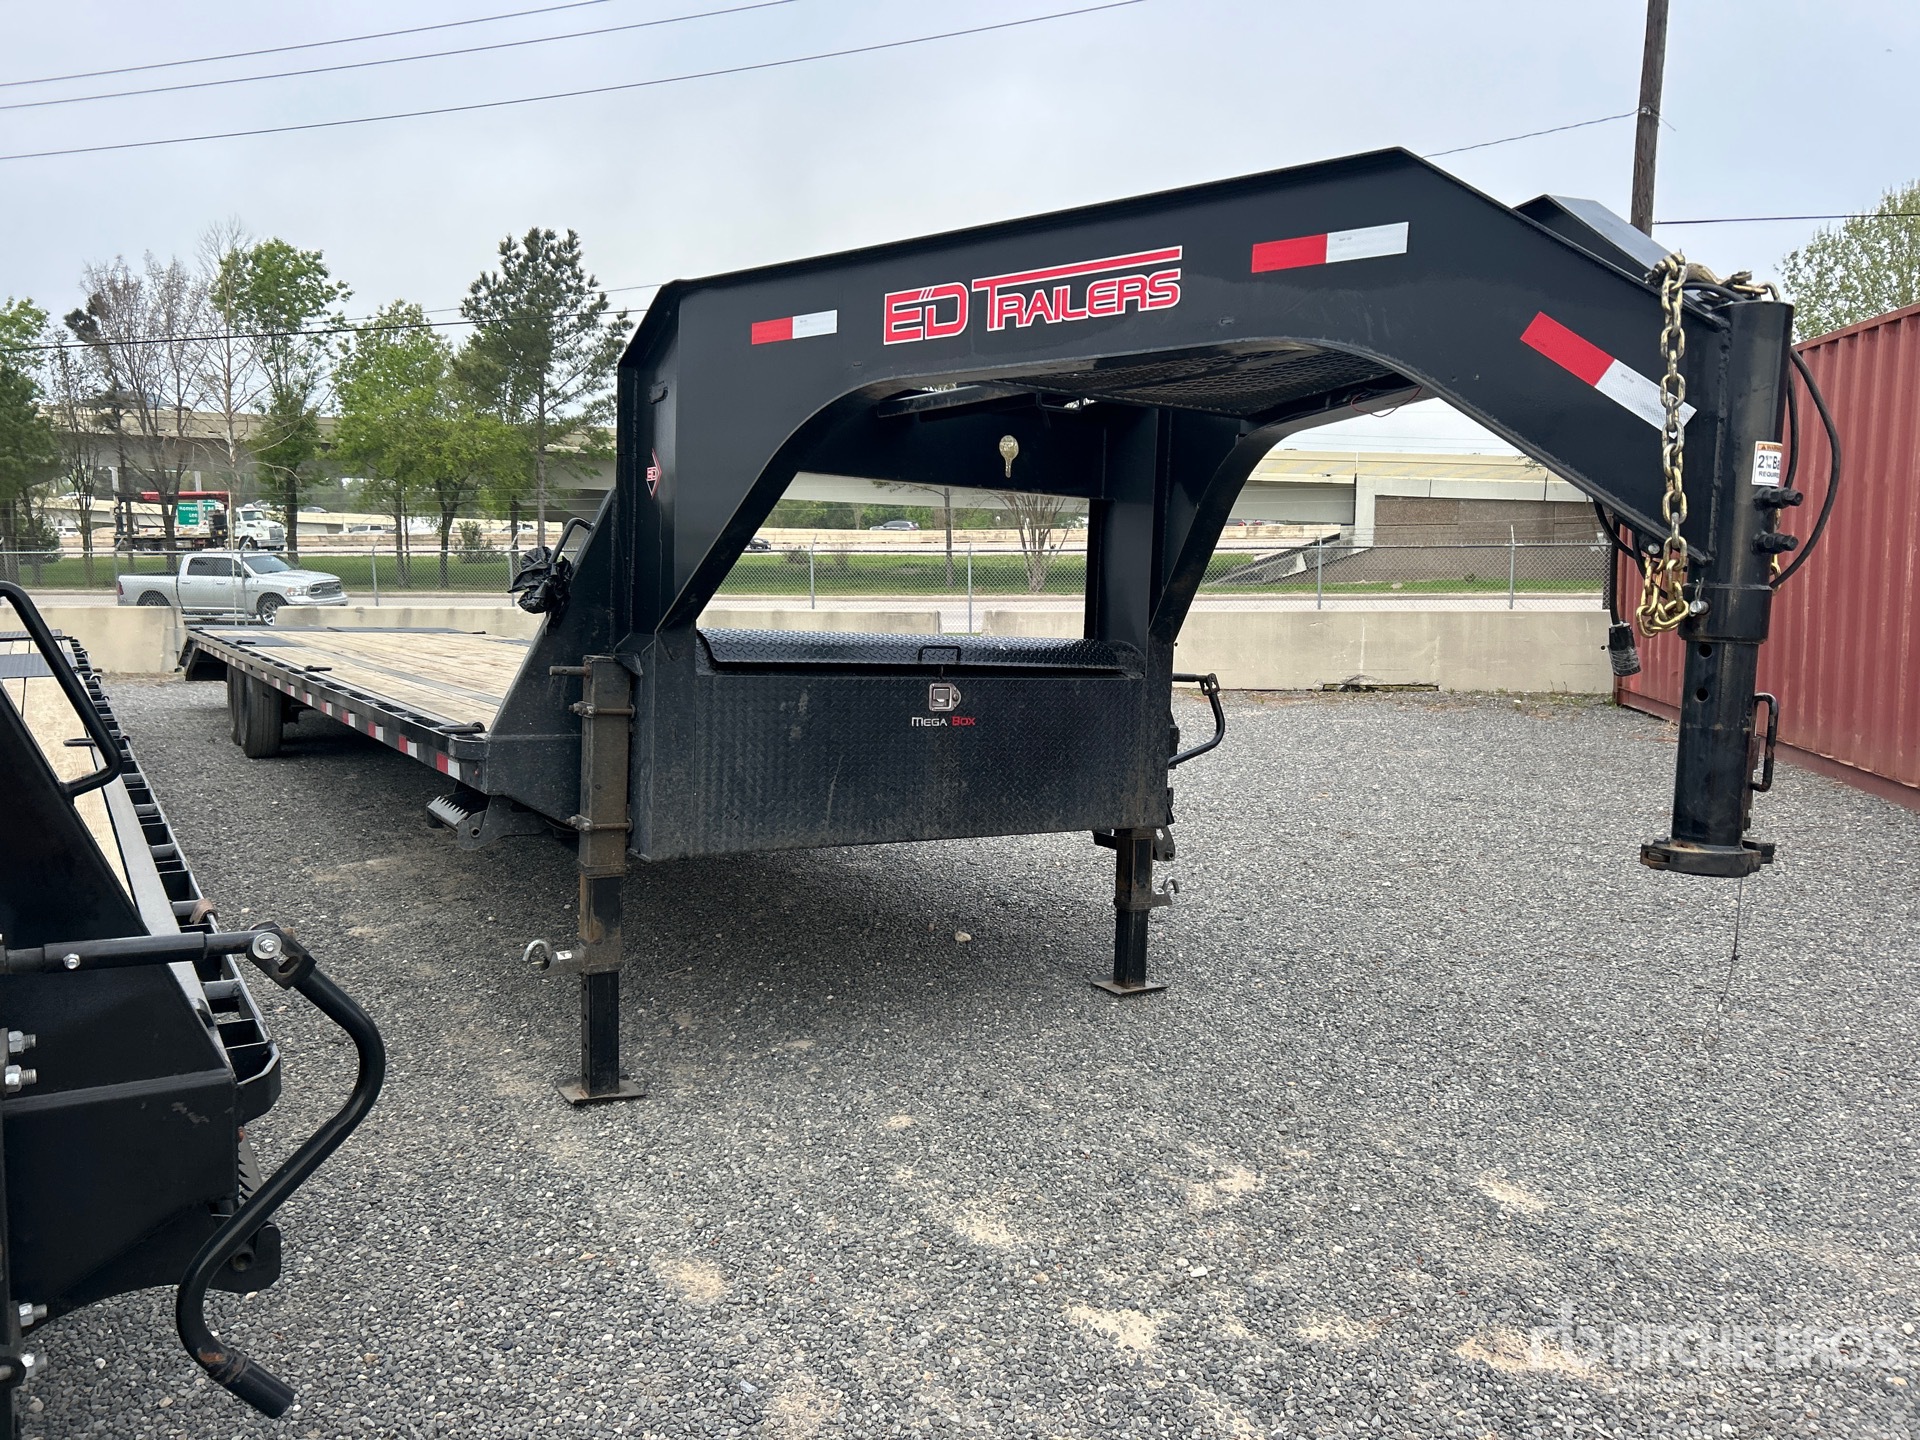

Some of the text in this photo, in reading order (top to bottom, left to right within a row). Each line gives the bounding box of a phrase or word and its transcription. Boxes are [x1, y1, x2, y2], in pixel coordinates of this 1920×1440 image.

[883, 245, 1183, 345] ED TRAILERS
[911, 716, 976, 727] MEGA BOX
